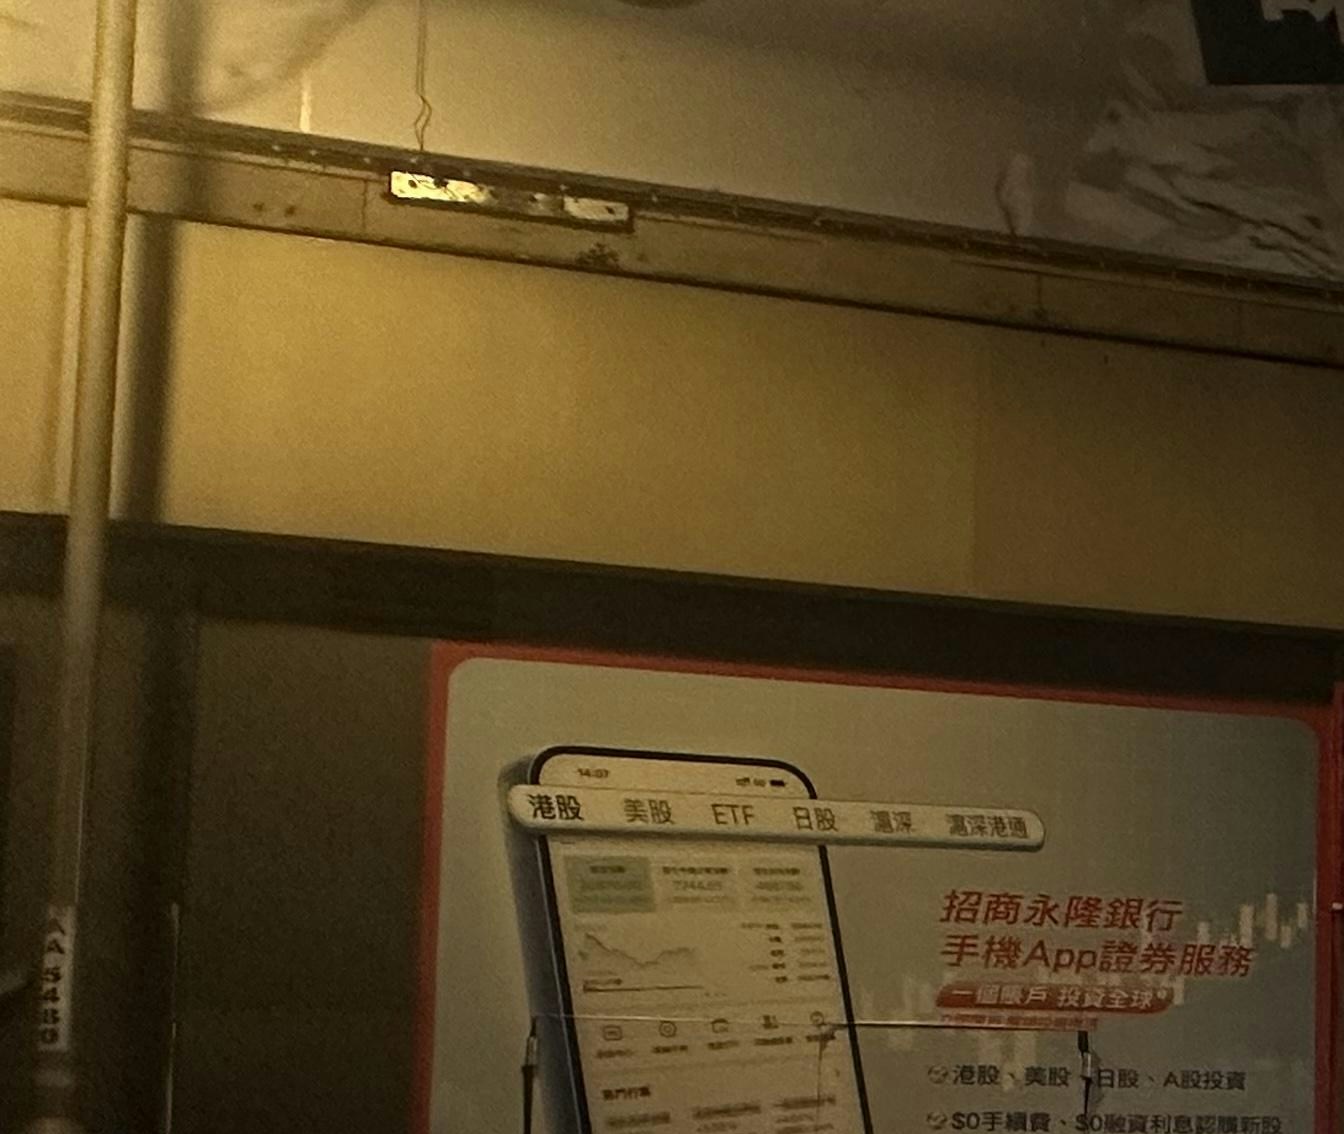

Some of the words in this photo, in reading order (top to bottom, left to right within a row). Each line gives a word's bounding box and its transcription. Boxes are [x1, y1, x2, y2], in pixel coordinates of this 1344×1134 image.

[528, 793, 585, 822] 港股
[623, 798, 676, 826] 美股
[711, 803, 756, 826] ETF
[792, 806, 840, 832] 日股
[939, 889, 1184, 933] 招商永隆銀行
[939, 933, 1255, 978] 手機App證券服務
[951, 1064, 1248, 1091] 港股、美股日股、A股投資
